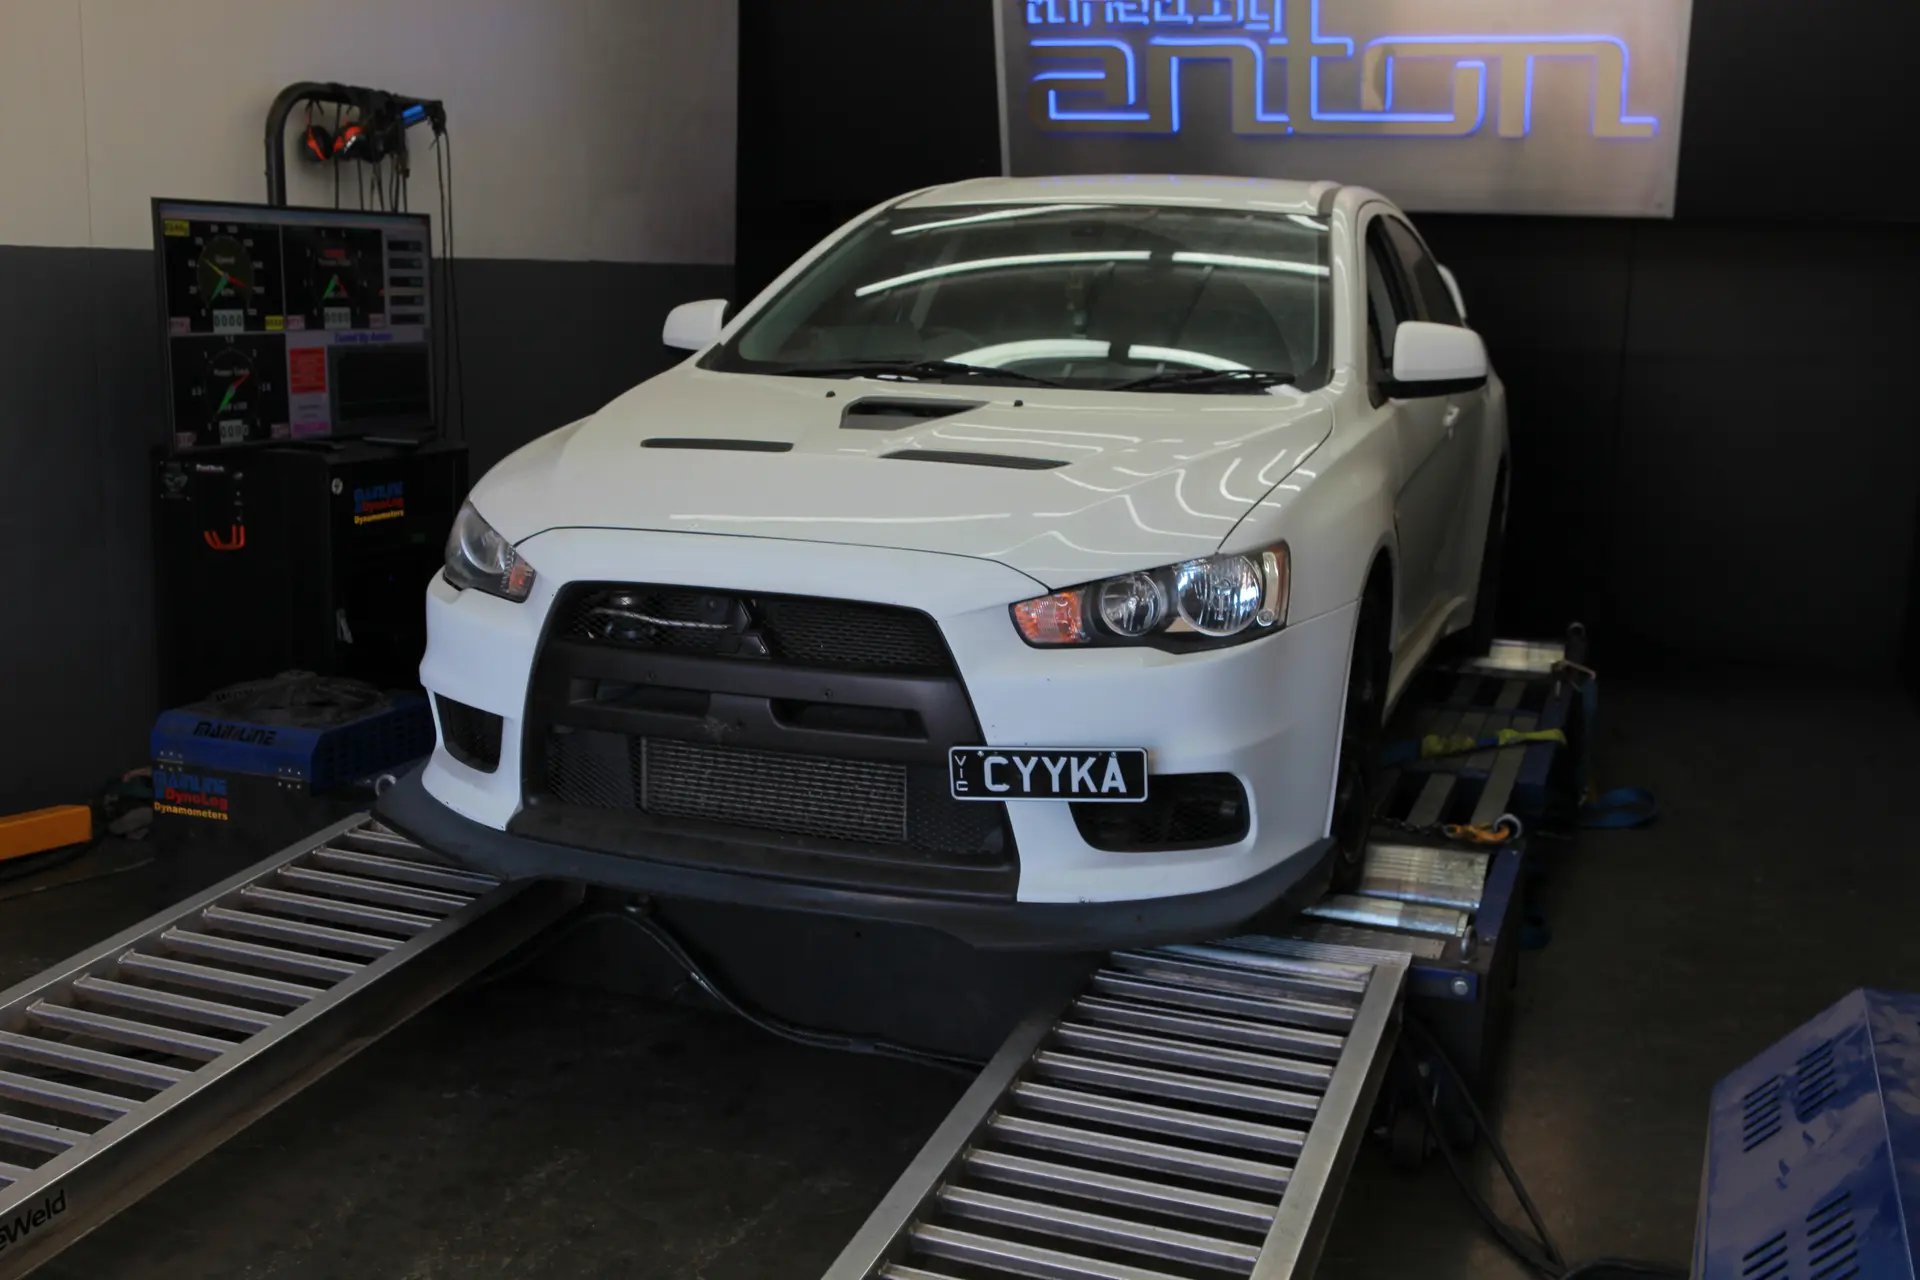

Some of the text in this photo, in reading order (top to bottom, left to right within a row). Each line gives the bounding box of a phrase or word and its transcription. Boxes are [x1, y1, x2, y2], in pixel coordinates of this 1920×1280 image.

[353, 509, 405, 526] Dynamometers
[954, 755, 969, 792] VIC
[983, 755, 1127, 793] CYYKA
[153, 801, 229, 821] Dynamometers
